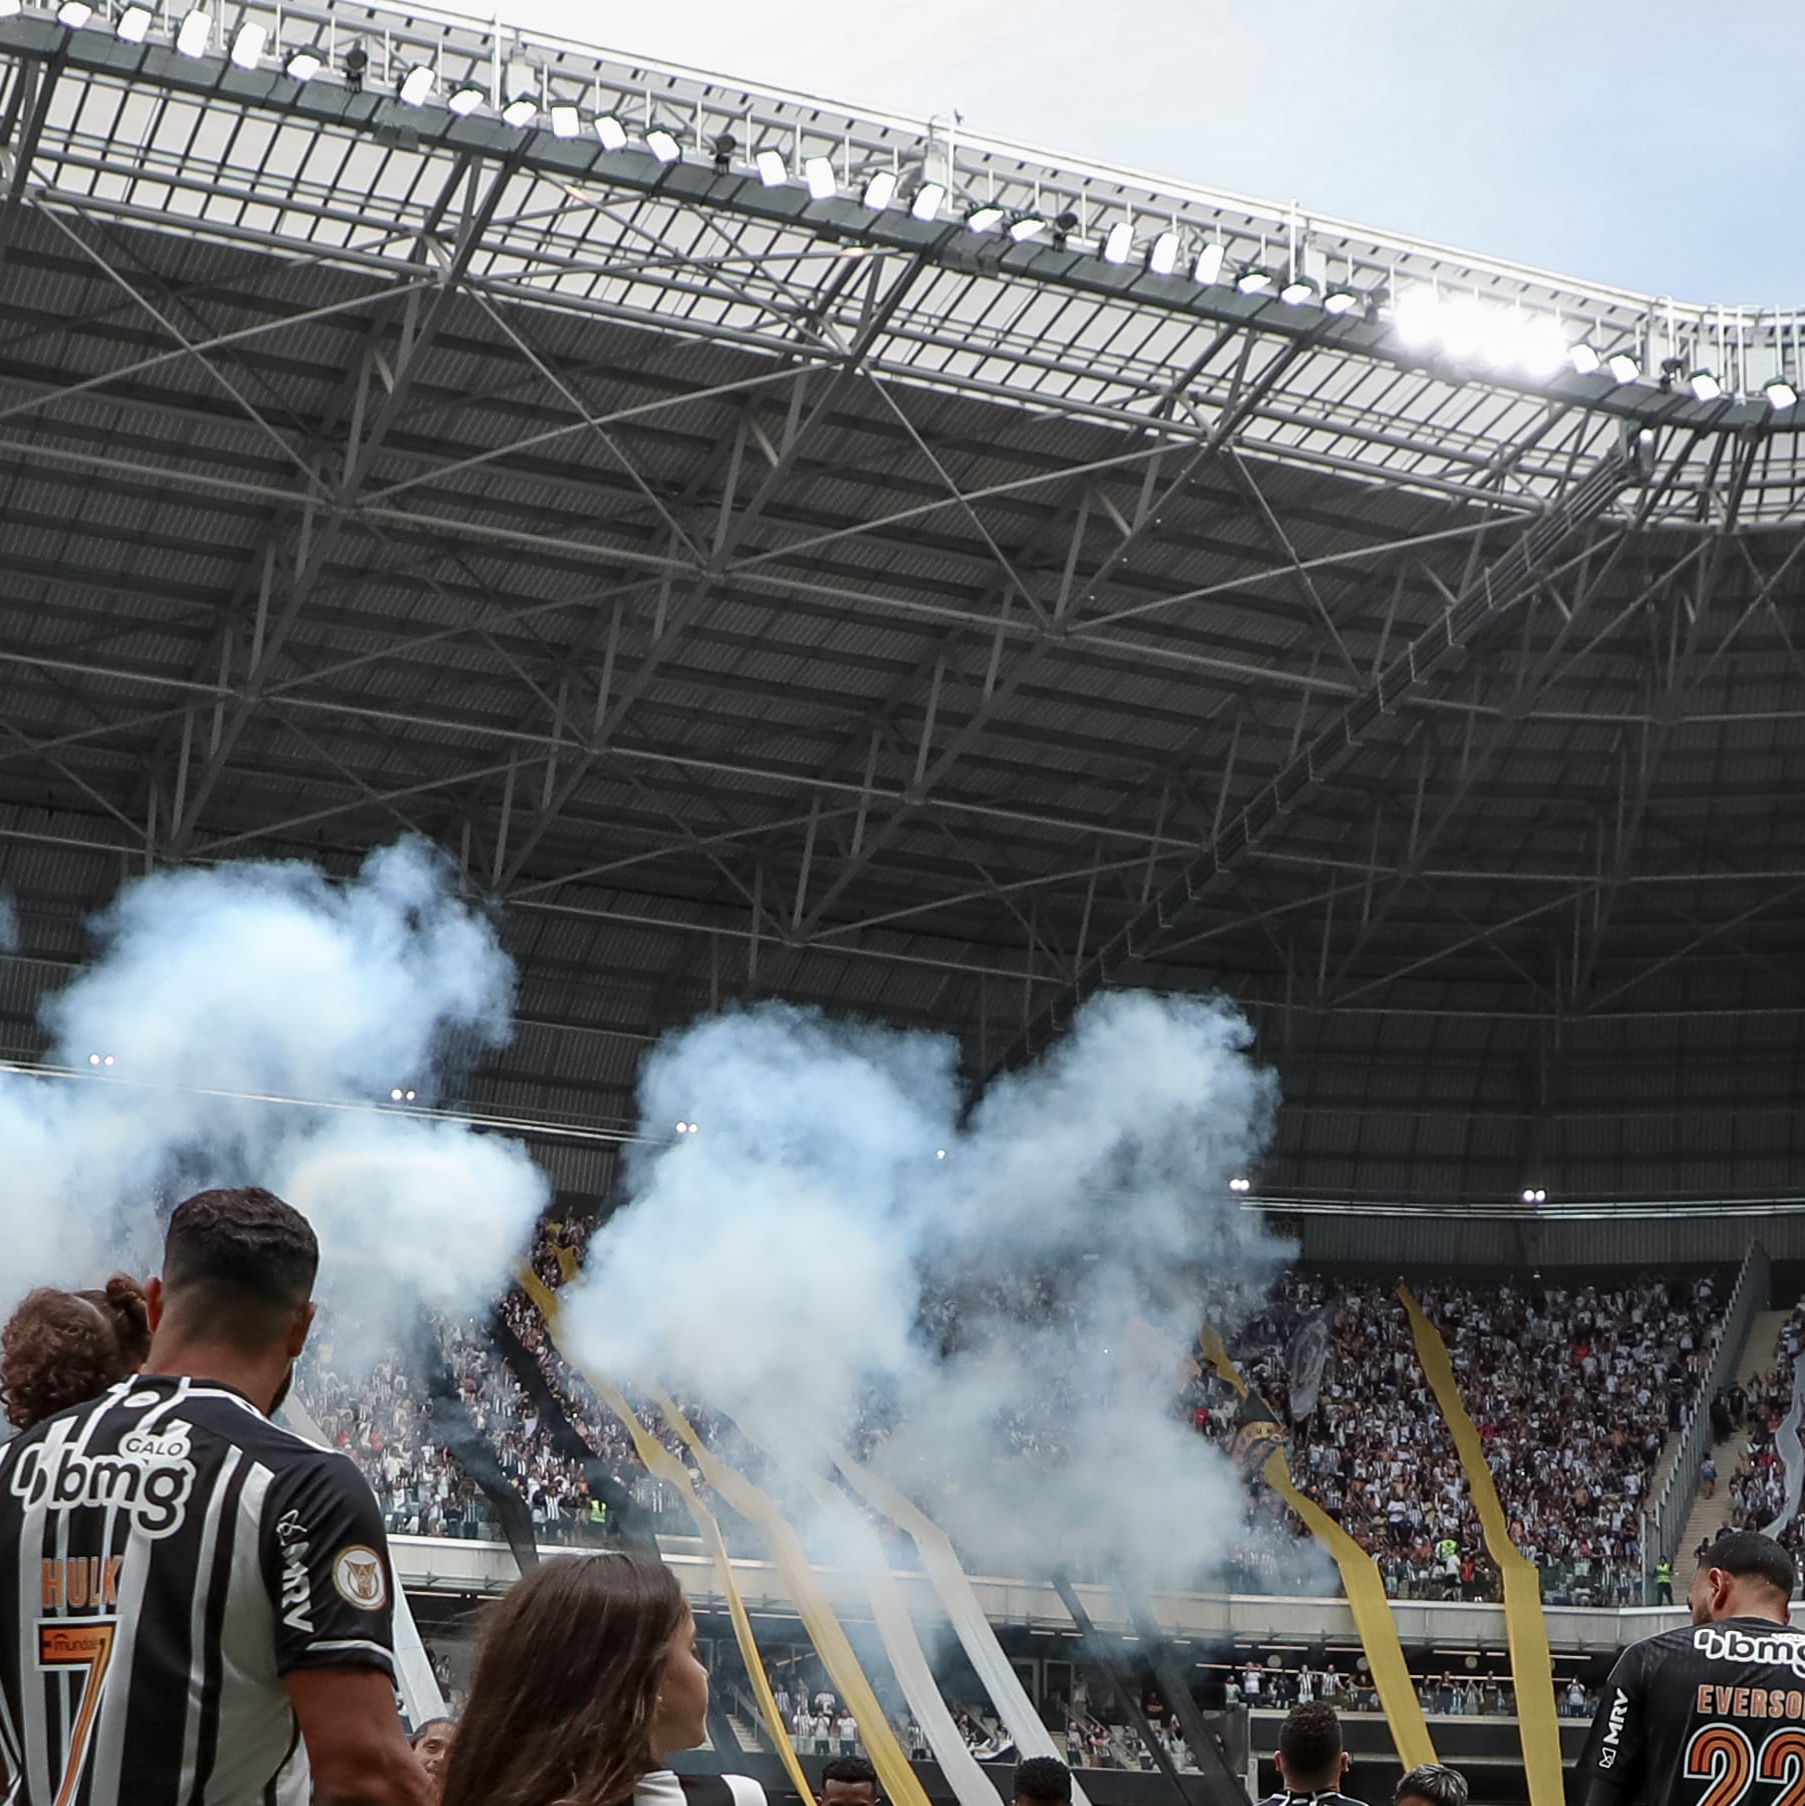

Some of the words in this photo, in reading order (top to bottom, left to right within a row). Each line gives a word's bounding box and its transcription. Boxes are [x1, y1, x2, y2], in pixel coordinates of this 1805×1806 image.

[126, 1437, 183, 1457] GALO
[56, 1452, 188, 1533] bmg
[42, 1556, 123, 1609] HULK
[1603, 1687, 1628, 1745] MRV
